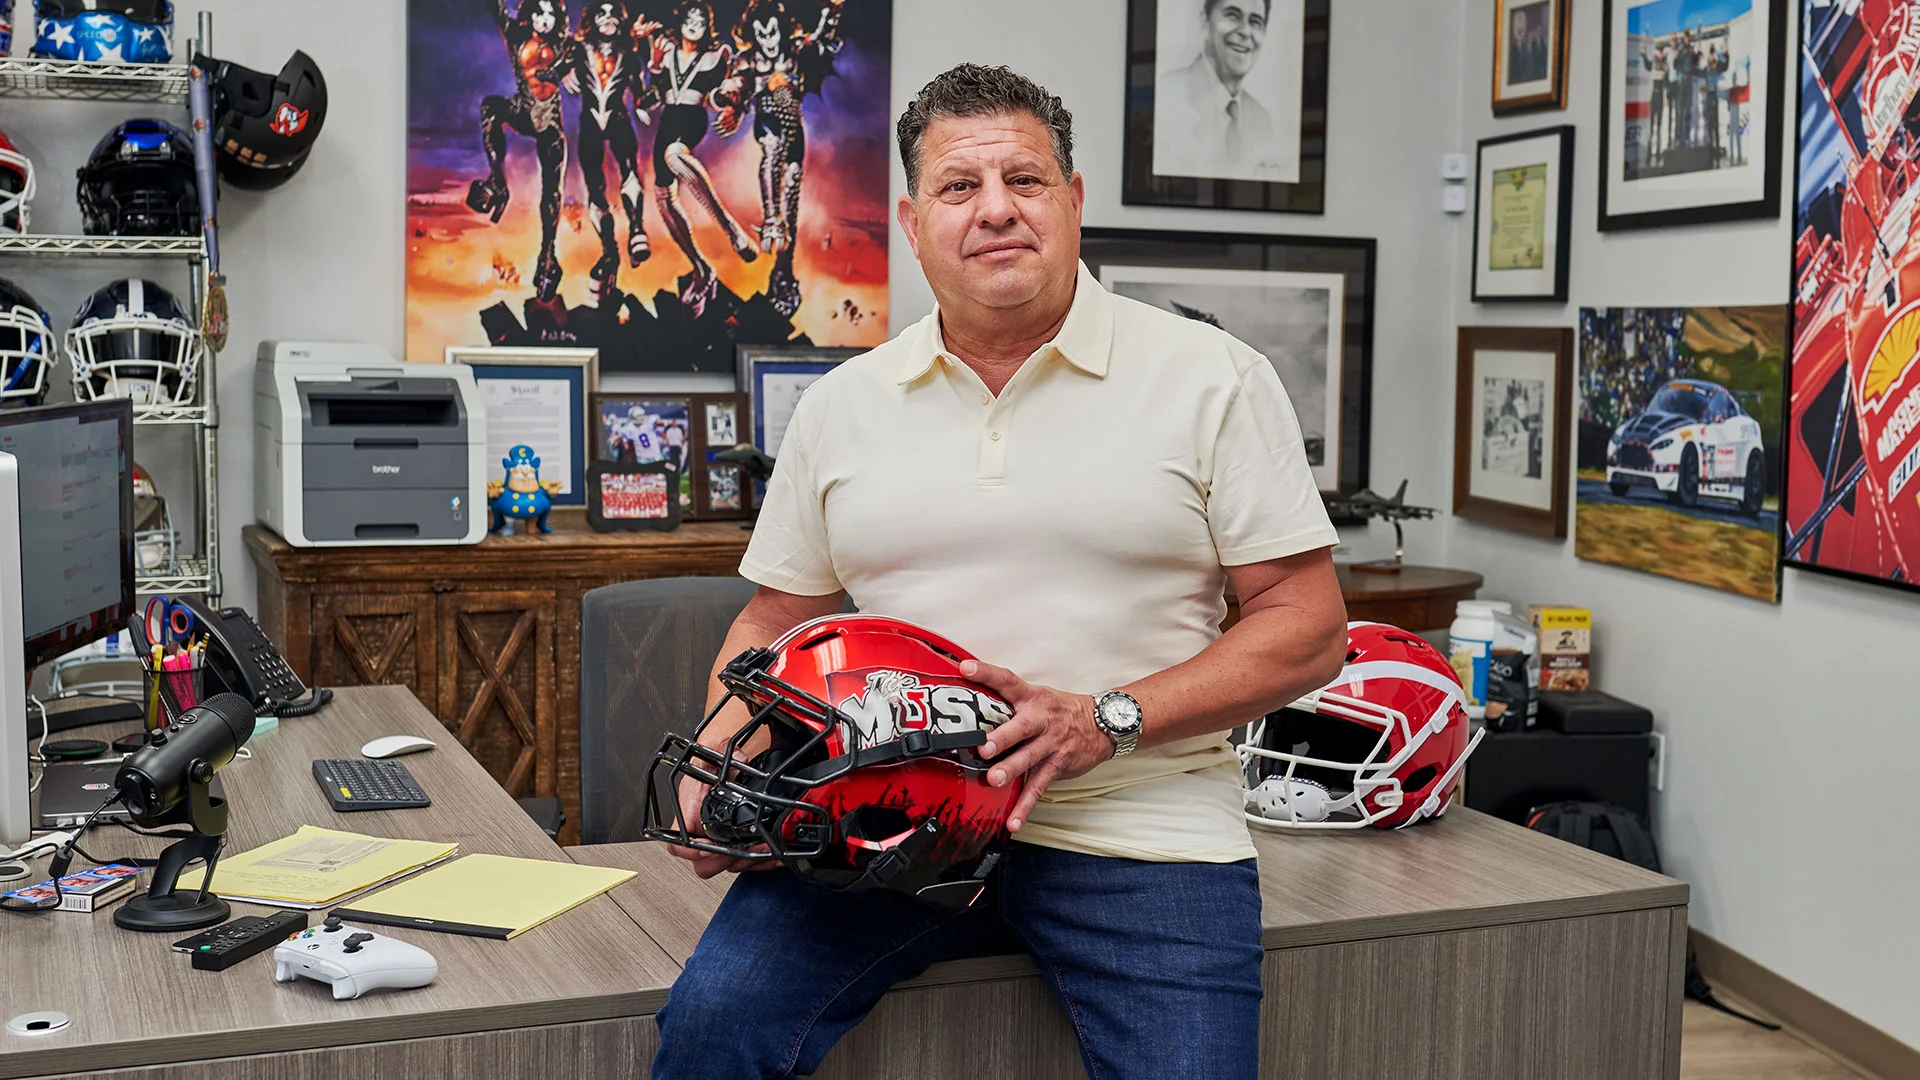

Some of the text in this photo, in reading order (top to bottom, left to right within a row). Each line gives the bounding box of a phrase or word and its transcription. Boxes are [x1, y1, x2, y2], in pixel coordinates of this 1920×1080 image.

[128, 382, 151, 393] LIONS
[638, 433, 651, 449] 8
[372, 464, 401, 474] brother
[865, 670, 921, 695] The
